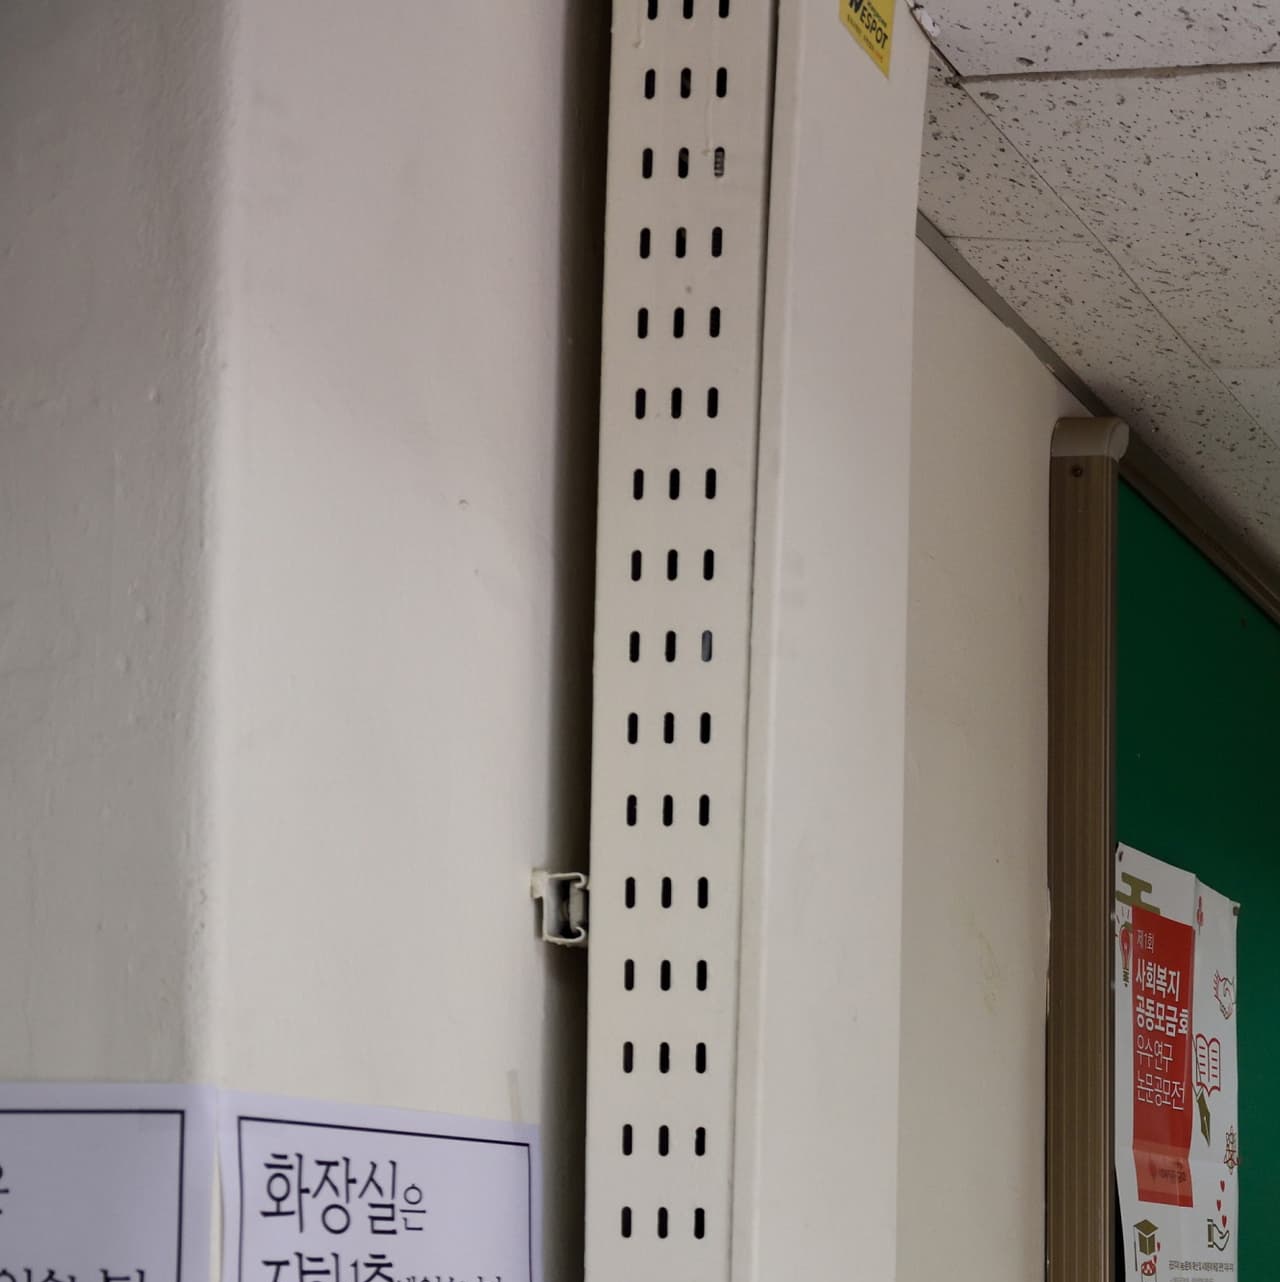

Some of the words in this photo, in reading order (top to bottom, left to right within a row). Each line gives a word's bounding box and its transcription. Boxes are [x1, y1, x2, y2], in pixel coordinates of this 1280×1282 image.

[1136, 958, 1180, 1002] 사회복지
[1136, 1071, 1185, 1111] 논문공모전
[260, 1153, 427, 1235] 화장실은
